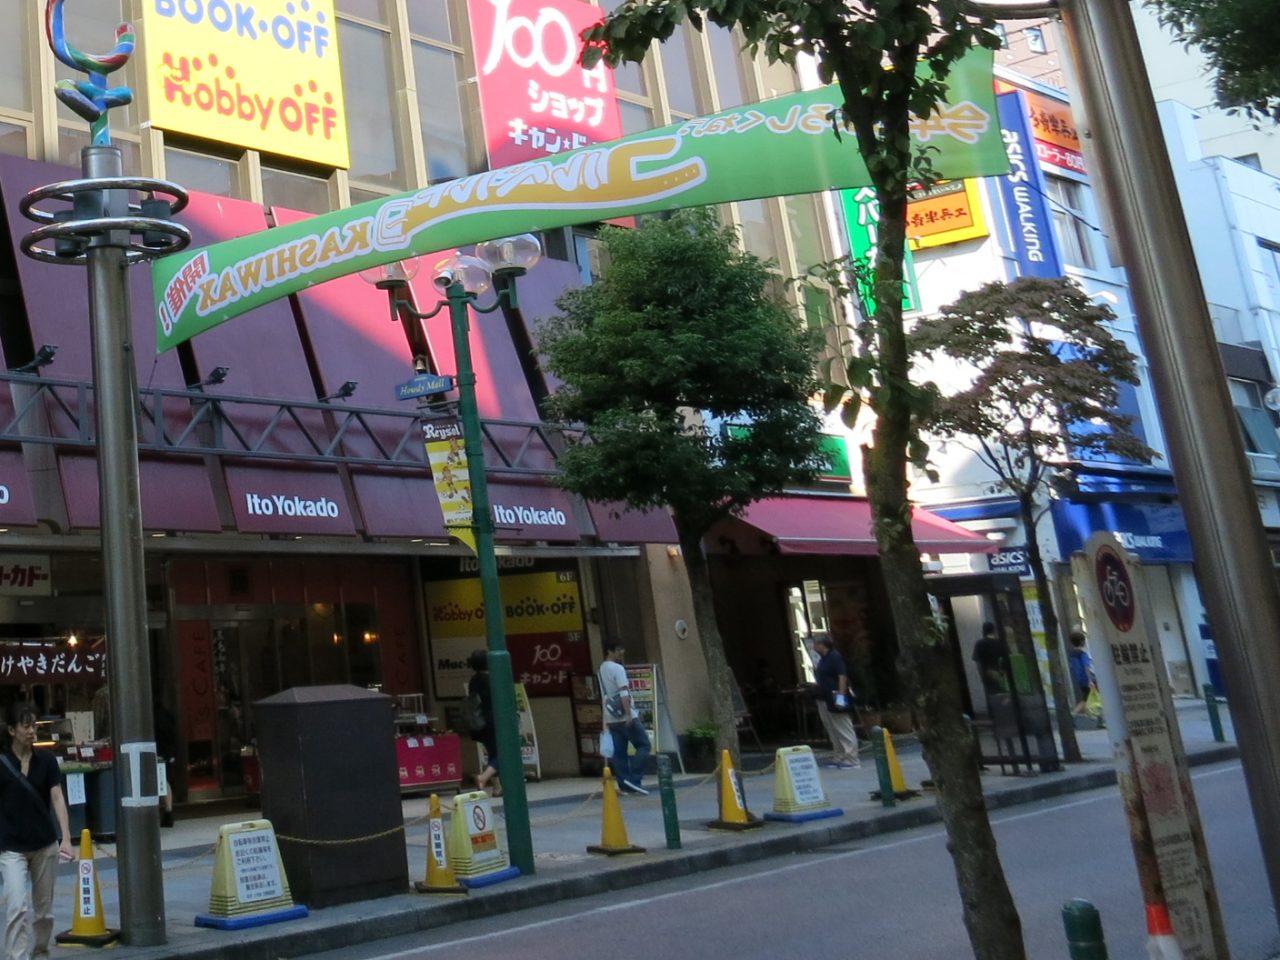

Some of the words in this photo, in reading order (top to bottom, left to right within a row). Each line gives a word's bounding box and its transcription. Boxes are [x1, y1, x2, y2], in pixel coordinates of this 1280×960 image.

[161, 50, 274, 131] Hobby
[278, 94, 337, 140] OFF
[528, 79, 605, 127] ショップ
[1000, 128, 1029, 183] asics
[1012, 187, 1044, 262] WALKING
[400, 382, 425, 396] Howdy
[426, 378, 445, 392] Mall
[423, 424, 461, 439] Reysol
[246, 493, 272, 515] Ito
[273, 495, 339, 518] Yokado
[494, 505, 515, 524] Ito
[514, 506, 566, 526] Yokado
[991, 551, 1025, 565] asics
[1, 653, 100, 677] けやきだんご
